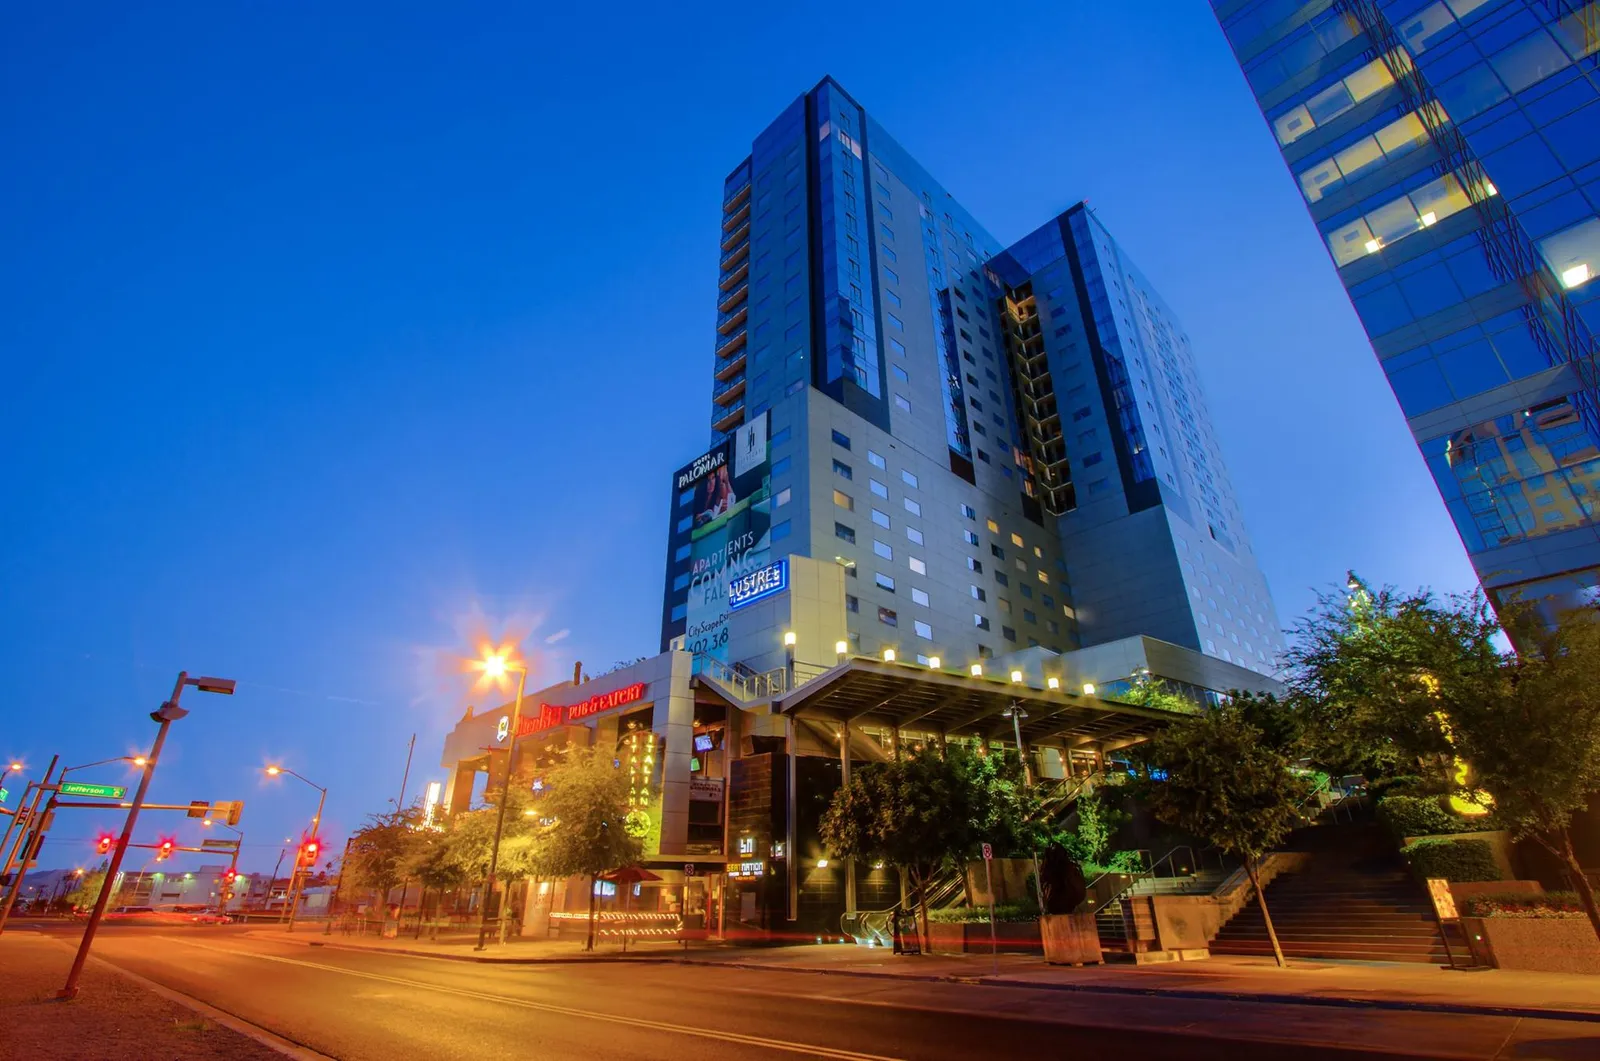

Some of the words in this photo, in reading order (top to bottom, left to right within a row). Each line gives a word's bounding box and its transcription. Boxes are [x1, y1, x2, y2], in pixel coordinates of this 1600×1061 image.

[678, 452, 725, 489] PALOMAR
[729, 566, 773, 598] LUSTRE
[567, 700, 589, 720] PUB
[589, 695, 599, 714] &
[599, 682, 645, 710] EATERY
[639, 733, 655, 807] ITALIAN
[65, 785, 105, 795] Jefferson
